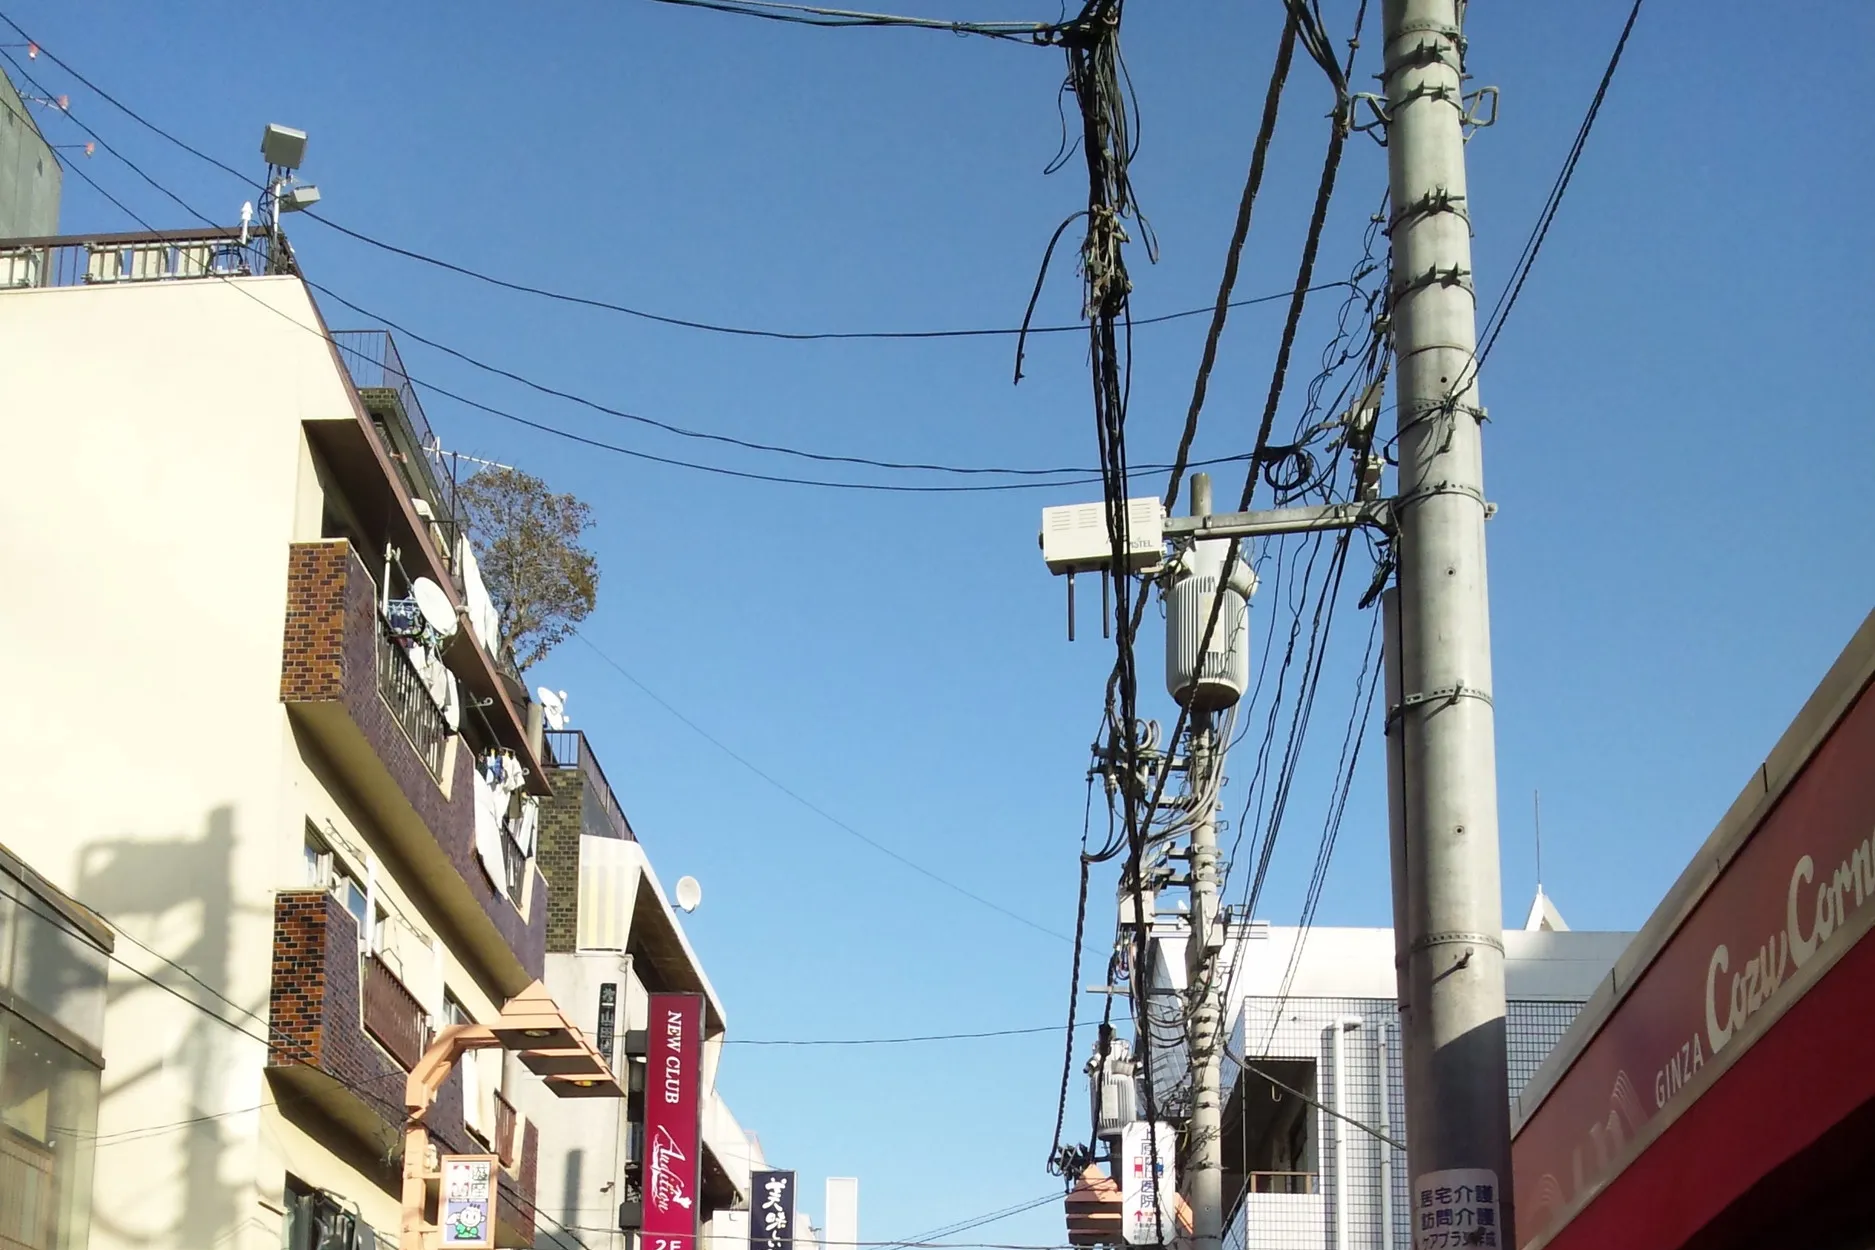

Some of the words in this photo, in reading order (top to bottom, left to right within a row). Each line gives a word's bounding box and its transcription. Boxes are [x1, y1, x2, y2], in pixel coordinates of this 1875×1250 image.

[667, 1010, 682, 1053] NEW
[665, 1055, 681, 1105] CLUB
[1654, 1032, 1705, 1110] GINZA
[1420, 1185, 1494, 1208] 居宅介護
[1421, 1208, 1496, 1231] 訪問介護
